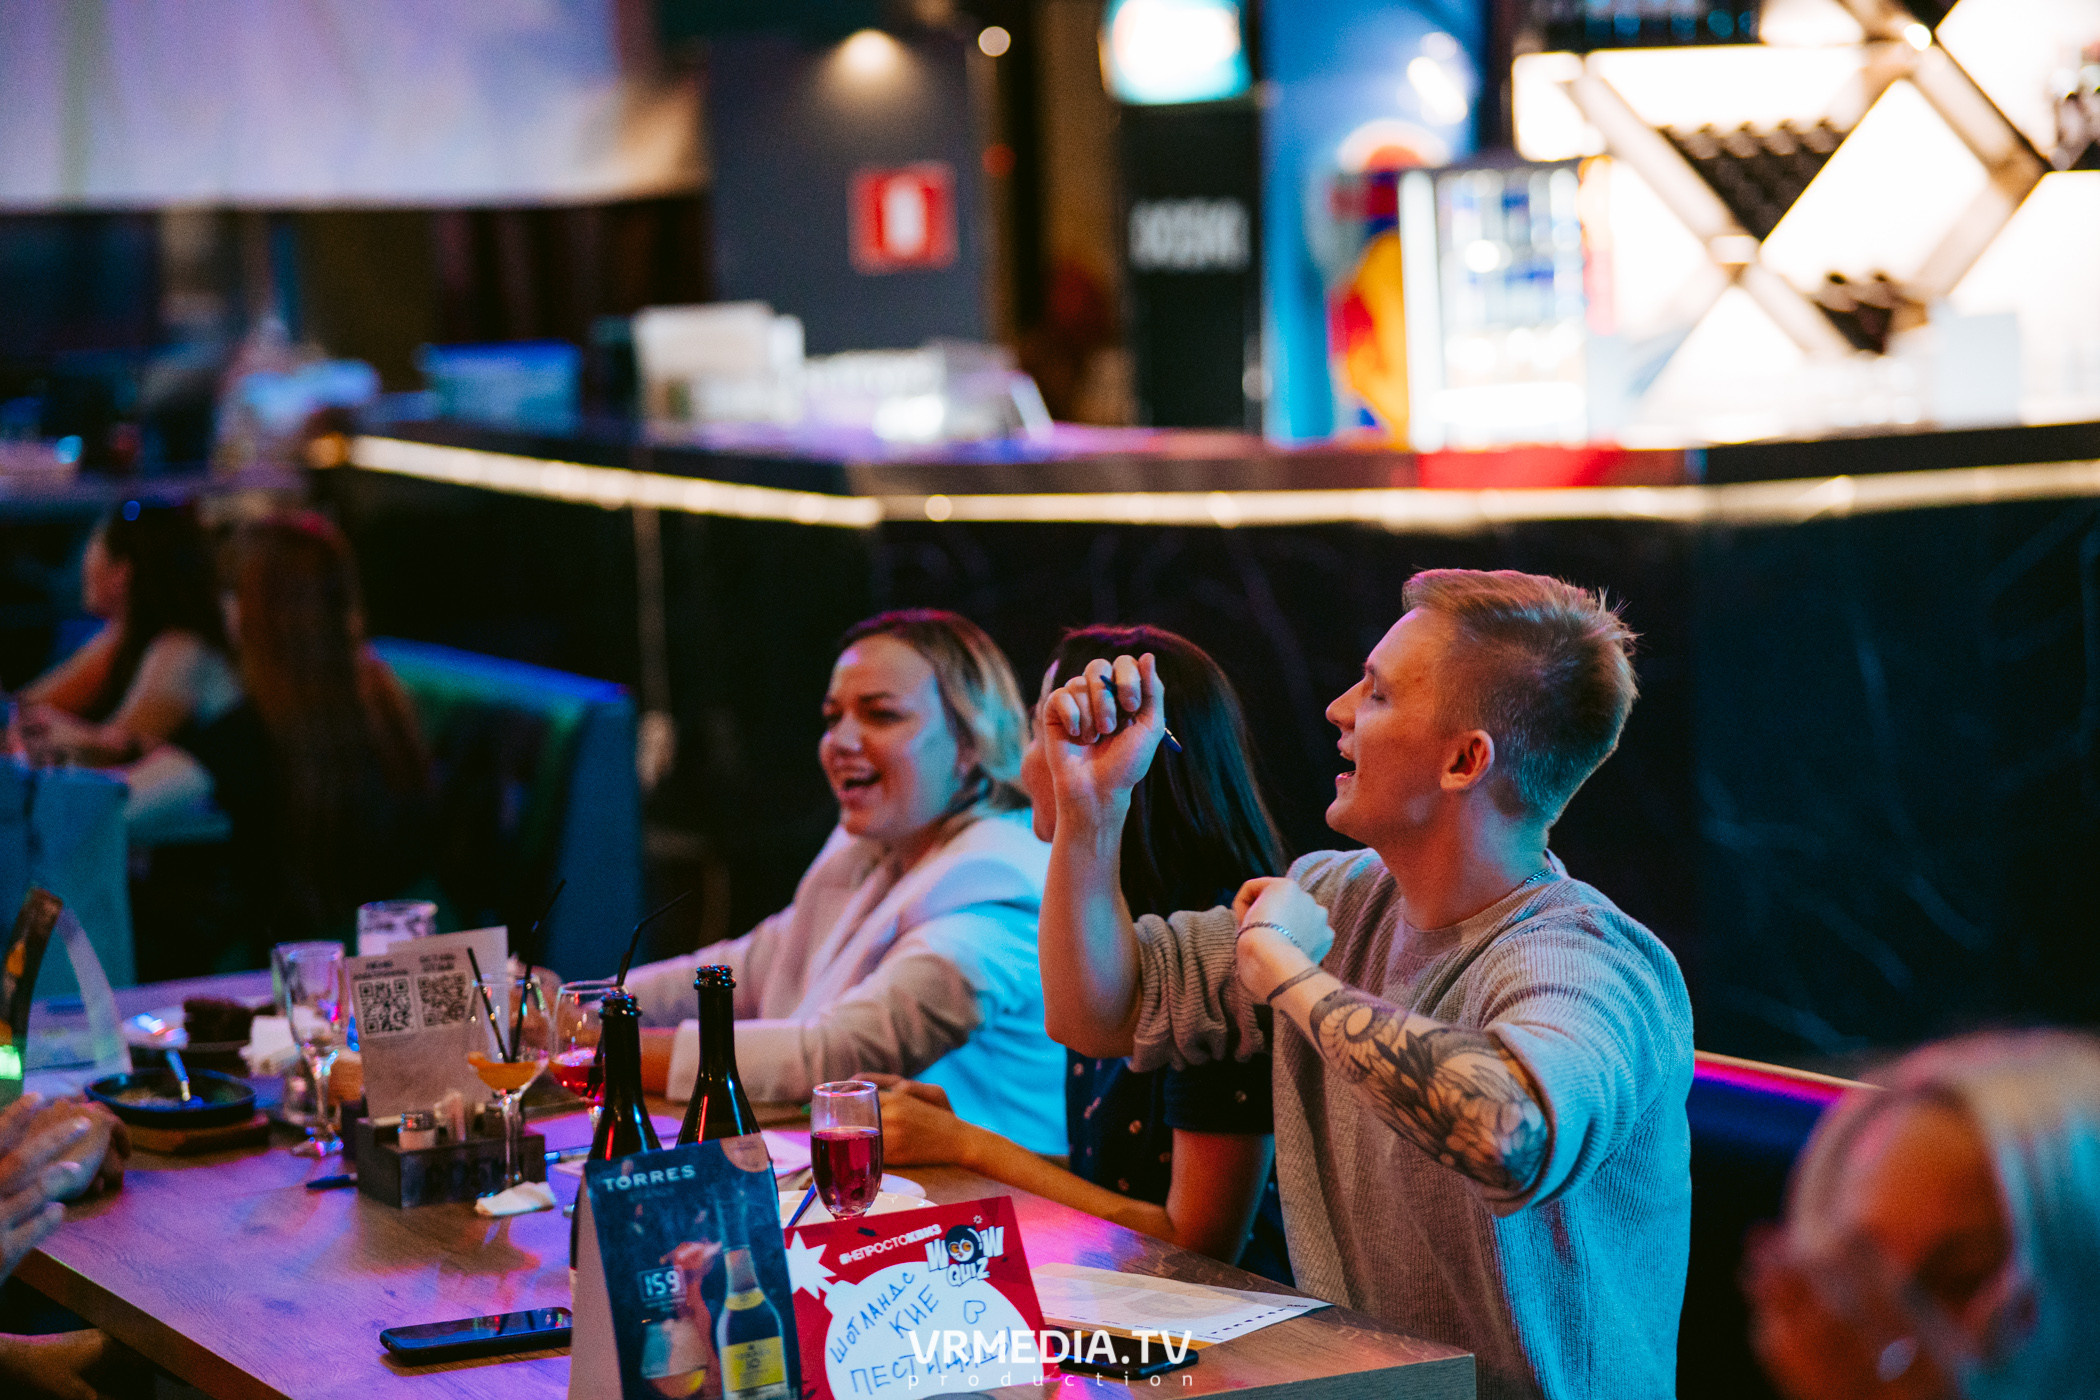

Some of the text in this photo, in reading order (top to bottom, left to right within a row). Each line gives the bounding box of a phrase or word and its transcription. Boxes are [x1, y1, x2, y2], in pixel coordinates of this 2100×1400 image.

[602, 1164, 696, 1192] TORRES
[644, 1270, 681, 1297] 159
[946, 1257, 990, 1287] QUIZ
[889, 1284, 939, 1339] КИЕ
